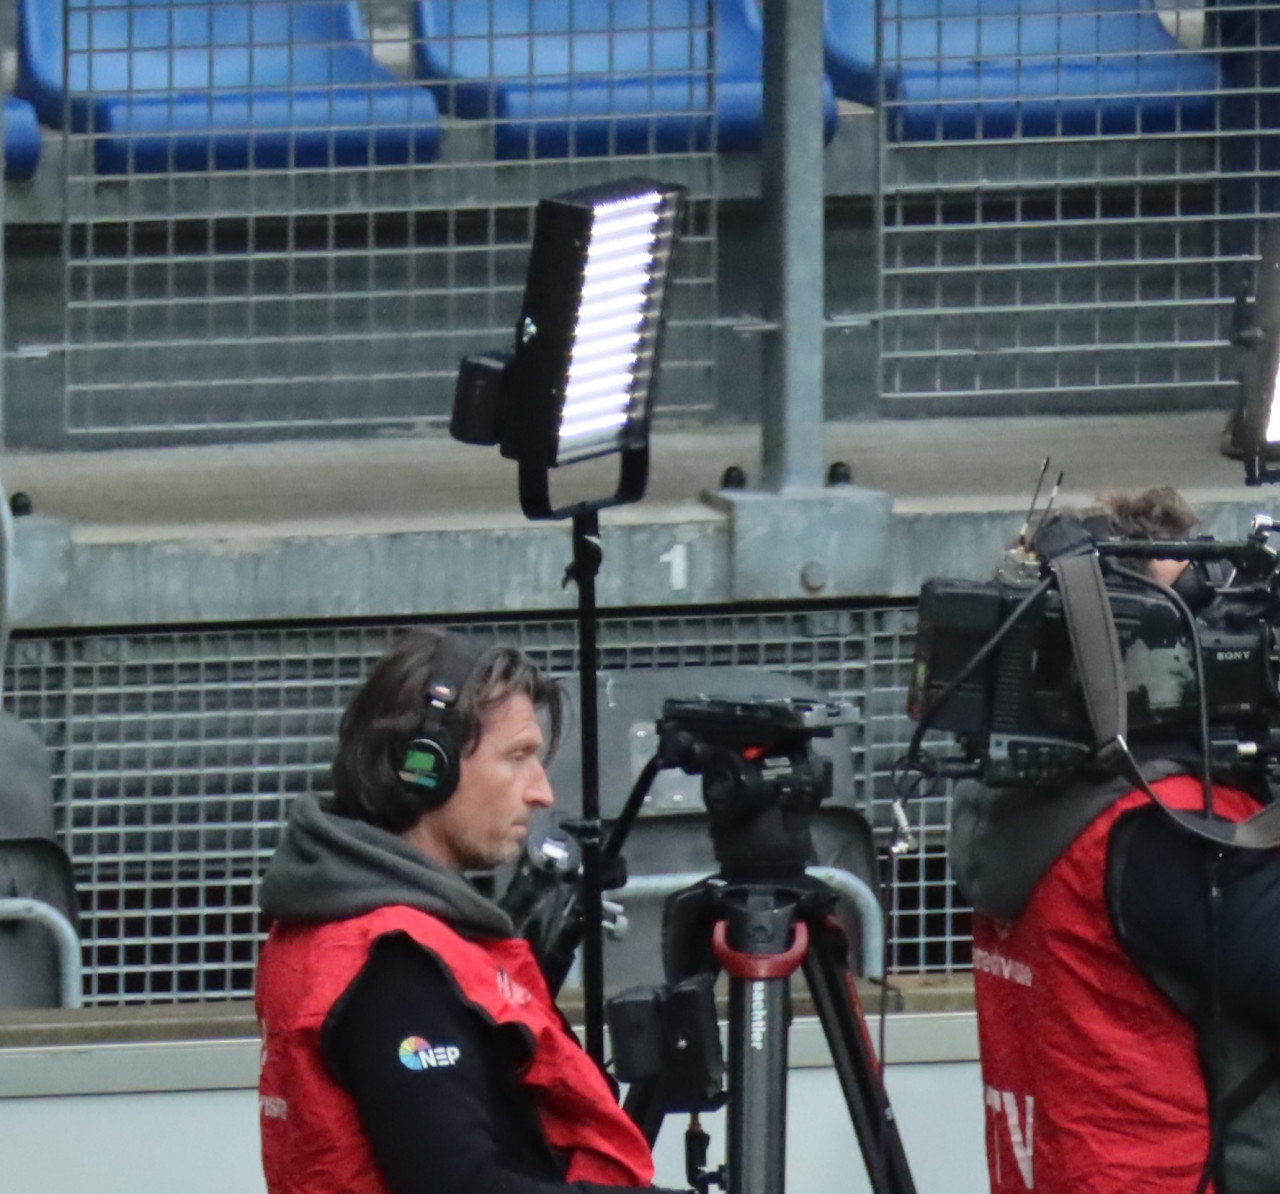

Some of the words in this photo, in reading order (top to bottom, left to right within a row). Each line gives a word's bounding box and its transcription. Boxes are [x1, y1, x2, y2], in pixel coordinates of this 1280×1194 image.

[660, 543, 687, 590] 1
[1216, 651, 1251, 661] SONY
[418, 1045, 461, 1069] NEP
